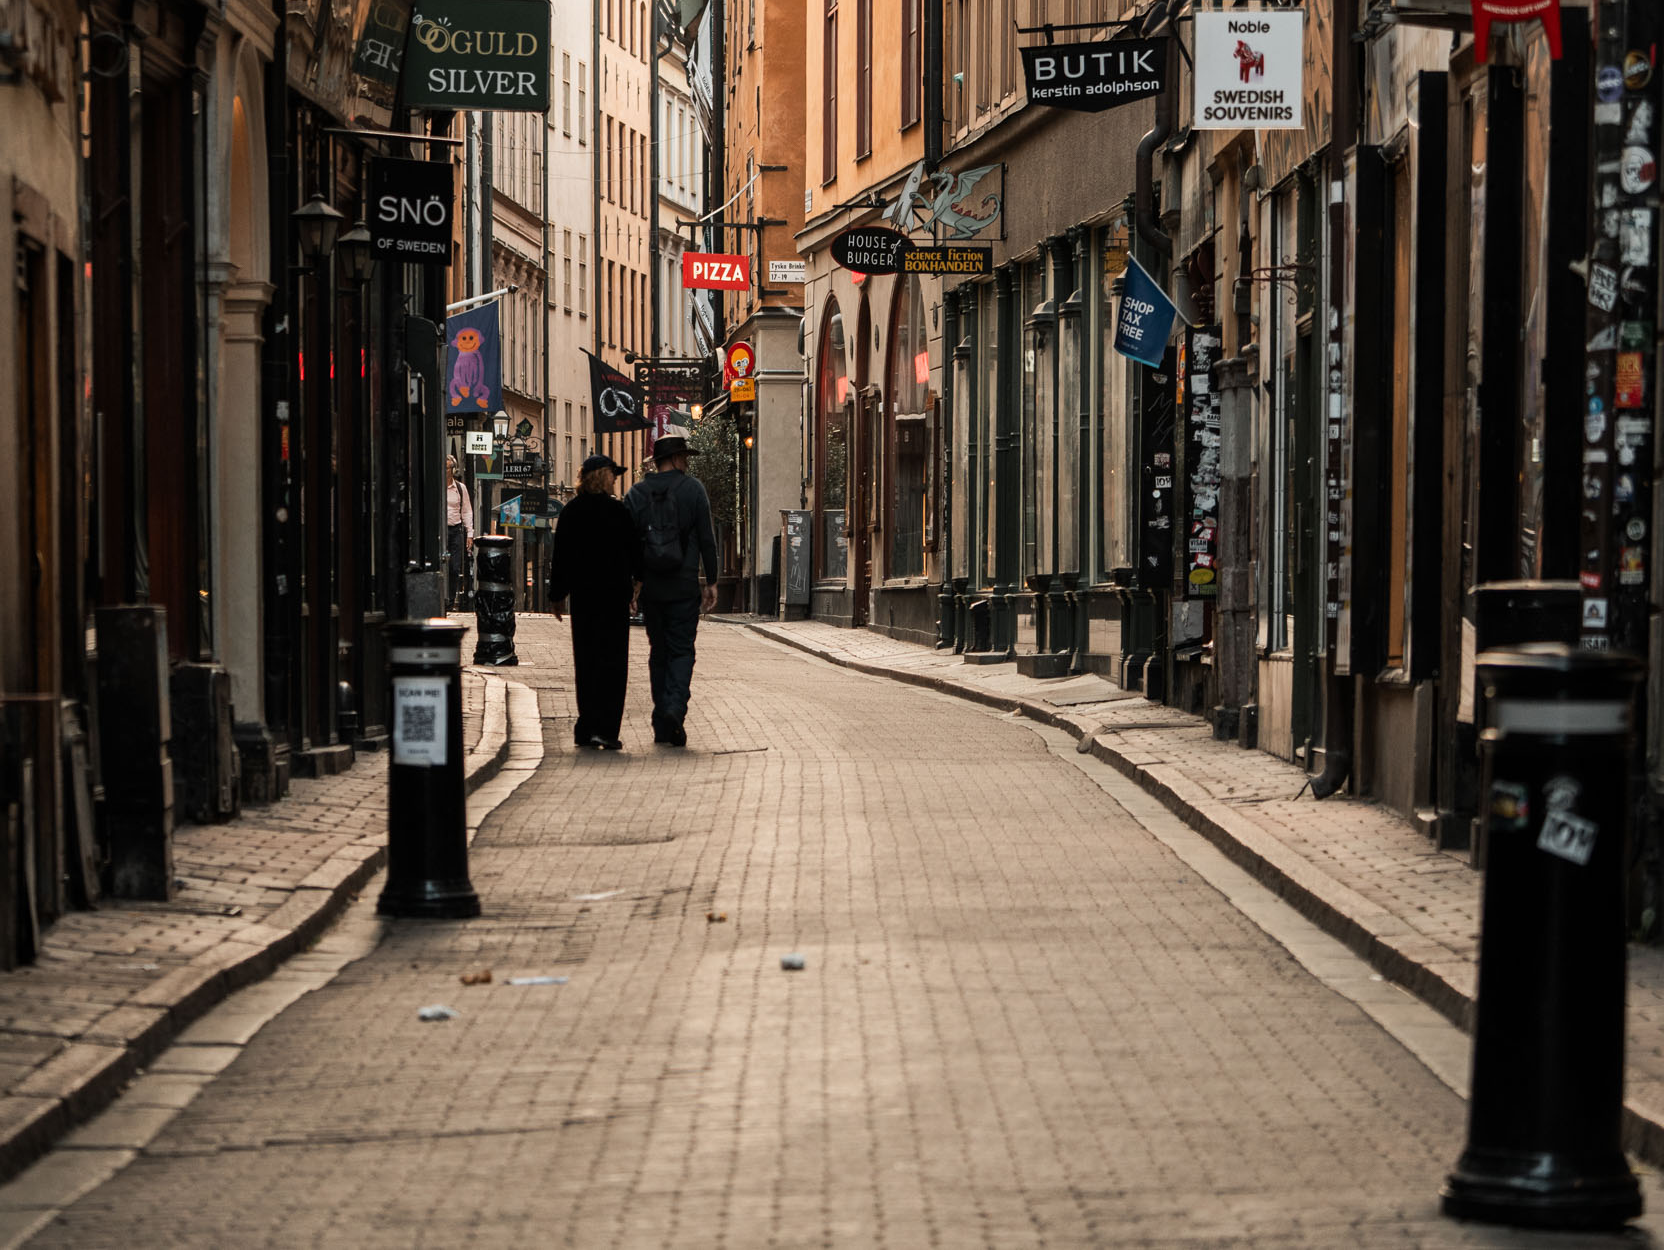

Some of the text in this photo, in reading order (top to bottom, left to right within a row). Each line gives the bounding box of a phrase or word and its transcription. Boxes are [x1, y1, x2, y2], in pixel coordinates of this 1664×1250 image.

[1228, 21, 1271, 33] Noble
[451, 30, 539, 57] GULD
[1035, 49, 1155, 81] BUTIK
[428, 68, 538, 96] SILVER
[1032, 79, 1160, 99] kerstin adolphson
[1213, 90, 1284, 104] SWEDISH
[1204, 106, 1293, 121] SOUVENIRS
[378, 195, 447, 227] SNÖ
[377, 238, 446, 254] OF SWEDEN
[848, 235, 887, 249] HOUSE
[847, 251, 898, 267] BURGER
[904, 261, 984, 272] BOKHANDELN
[692, 261, 744, 282] PIZZA
[1123, 296, 1155, 316] SHOP
[1122, 309, 1143, 326] TAX
[1119, 321, 1144, 341] FREE
[503, 465, 532, 473] LERI 67
